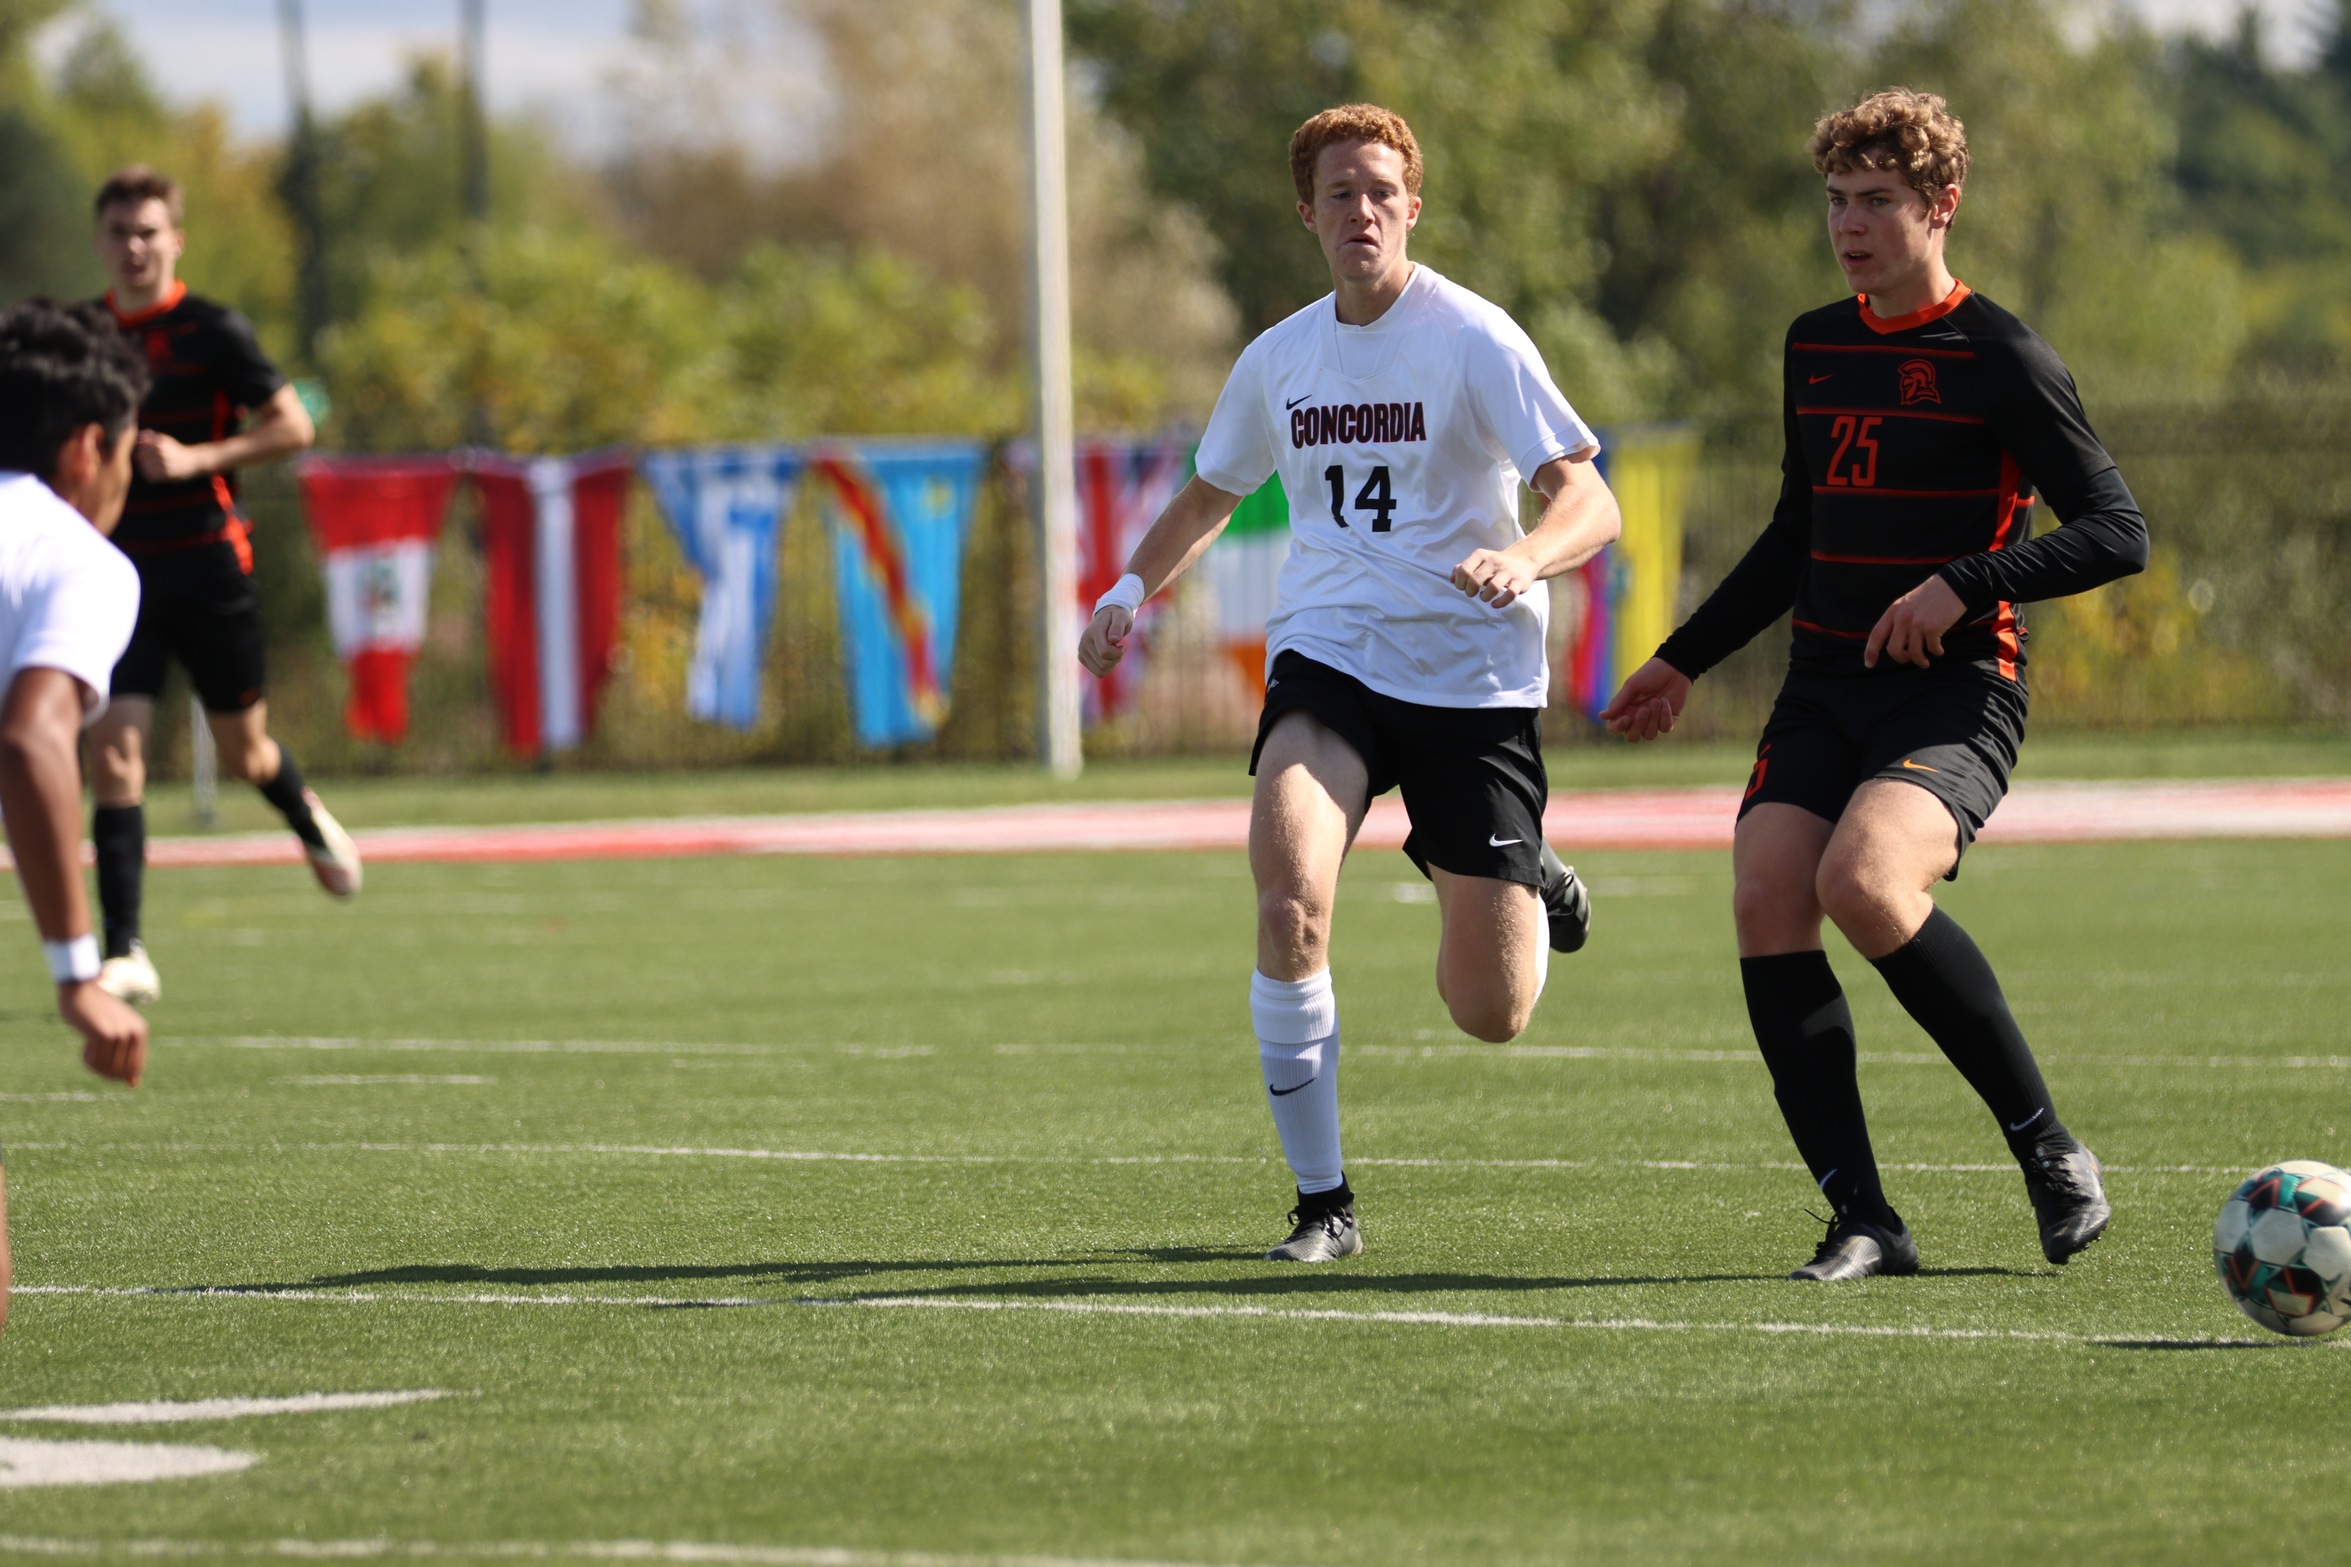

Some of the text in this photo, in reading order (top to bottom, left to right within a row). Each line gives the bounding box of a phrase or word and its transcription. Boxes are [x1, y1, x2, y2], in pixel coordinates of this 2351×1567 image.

[1291, 402, 1427, 449] CONCORDIA
[1826, 415, 1883, 487] 25
[1324, 464, 1397, 532] 14
